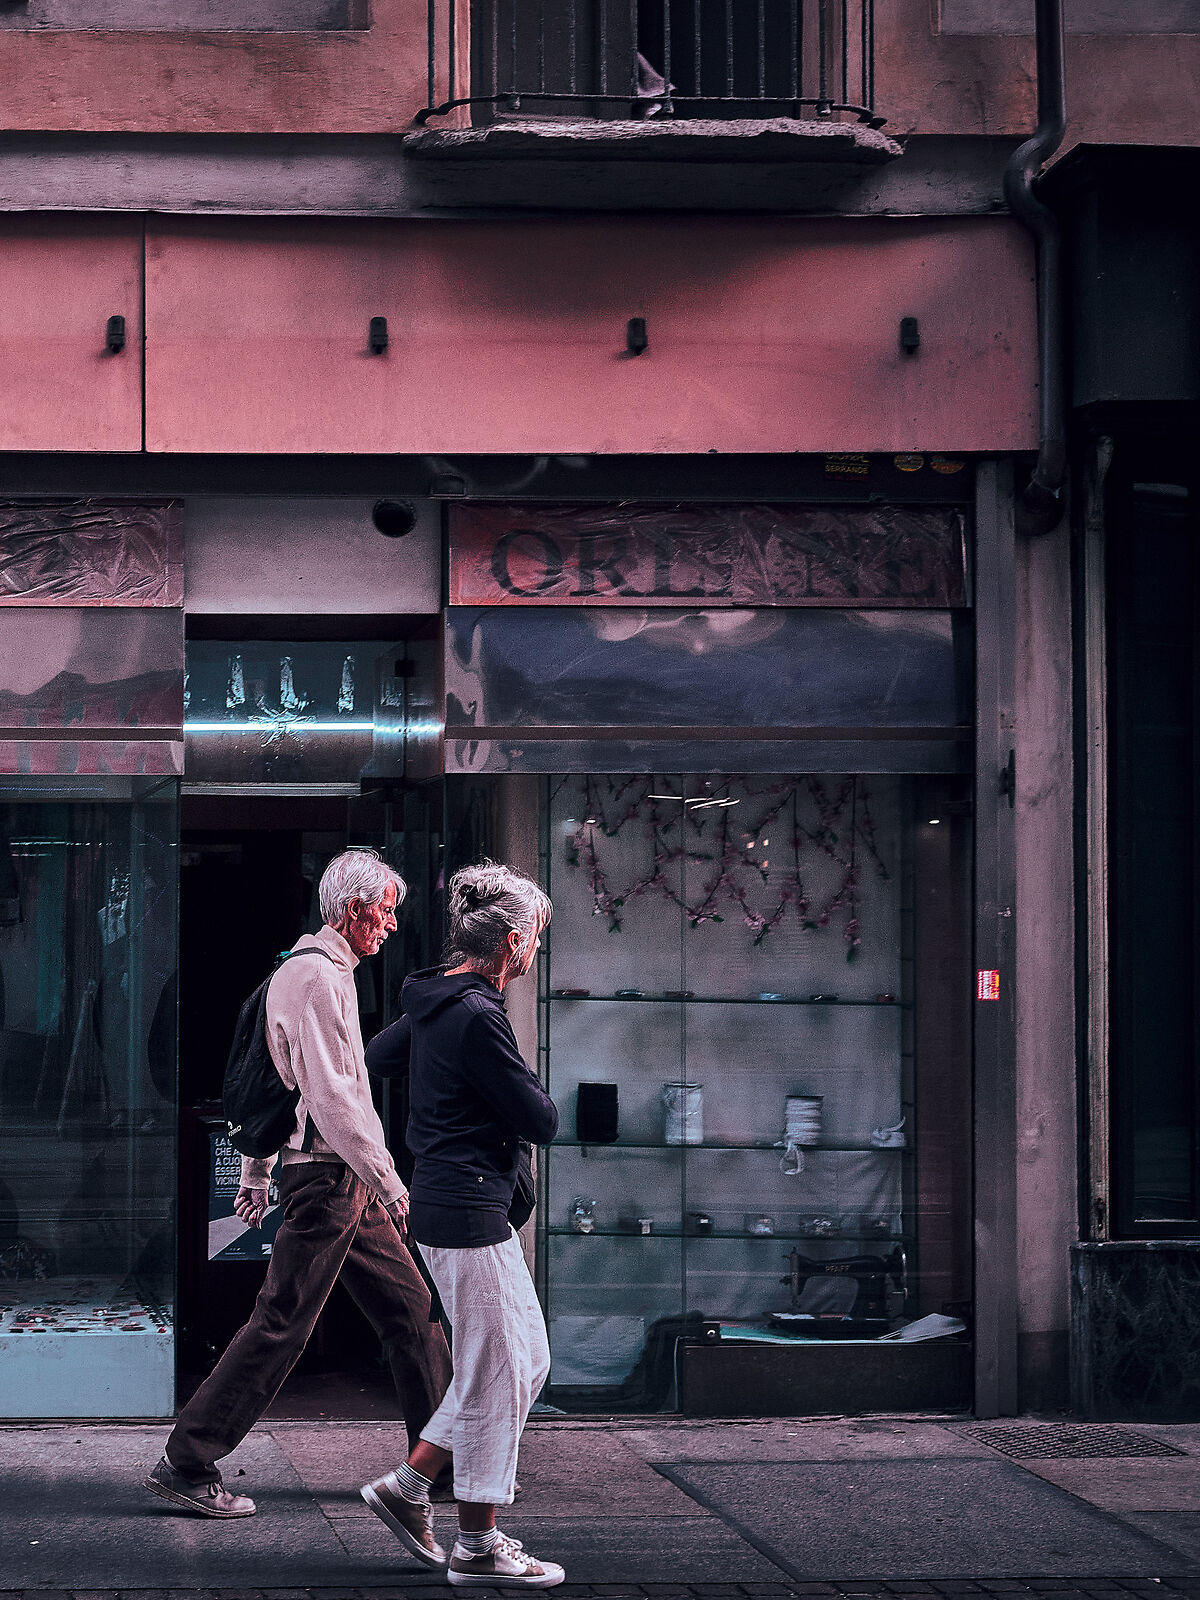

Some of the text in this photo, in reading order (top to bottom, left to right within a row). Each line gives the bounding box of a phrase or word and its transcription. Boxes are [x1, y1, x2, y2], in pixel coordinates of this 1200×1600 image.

[215, 1137, 226, 1146] LA
[215, 1147, 232, 1156] CHE
[215, 1157, 241, 1166] A CUO
